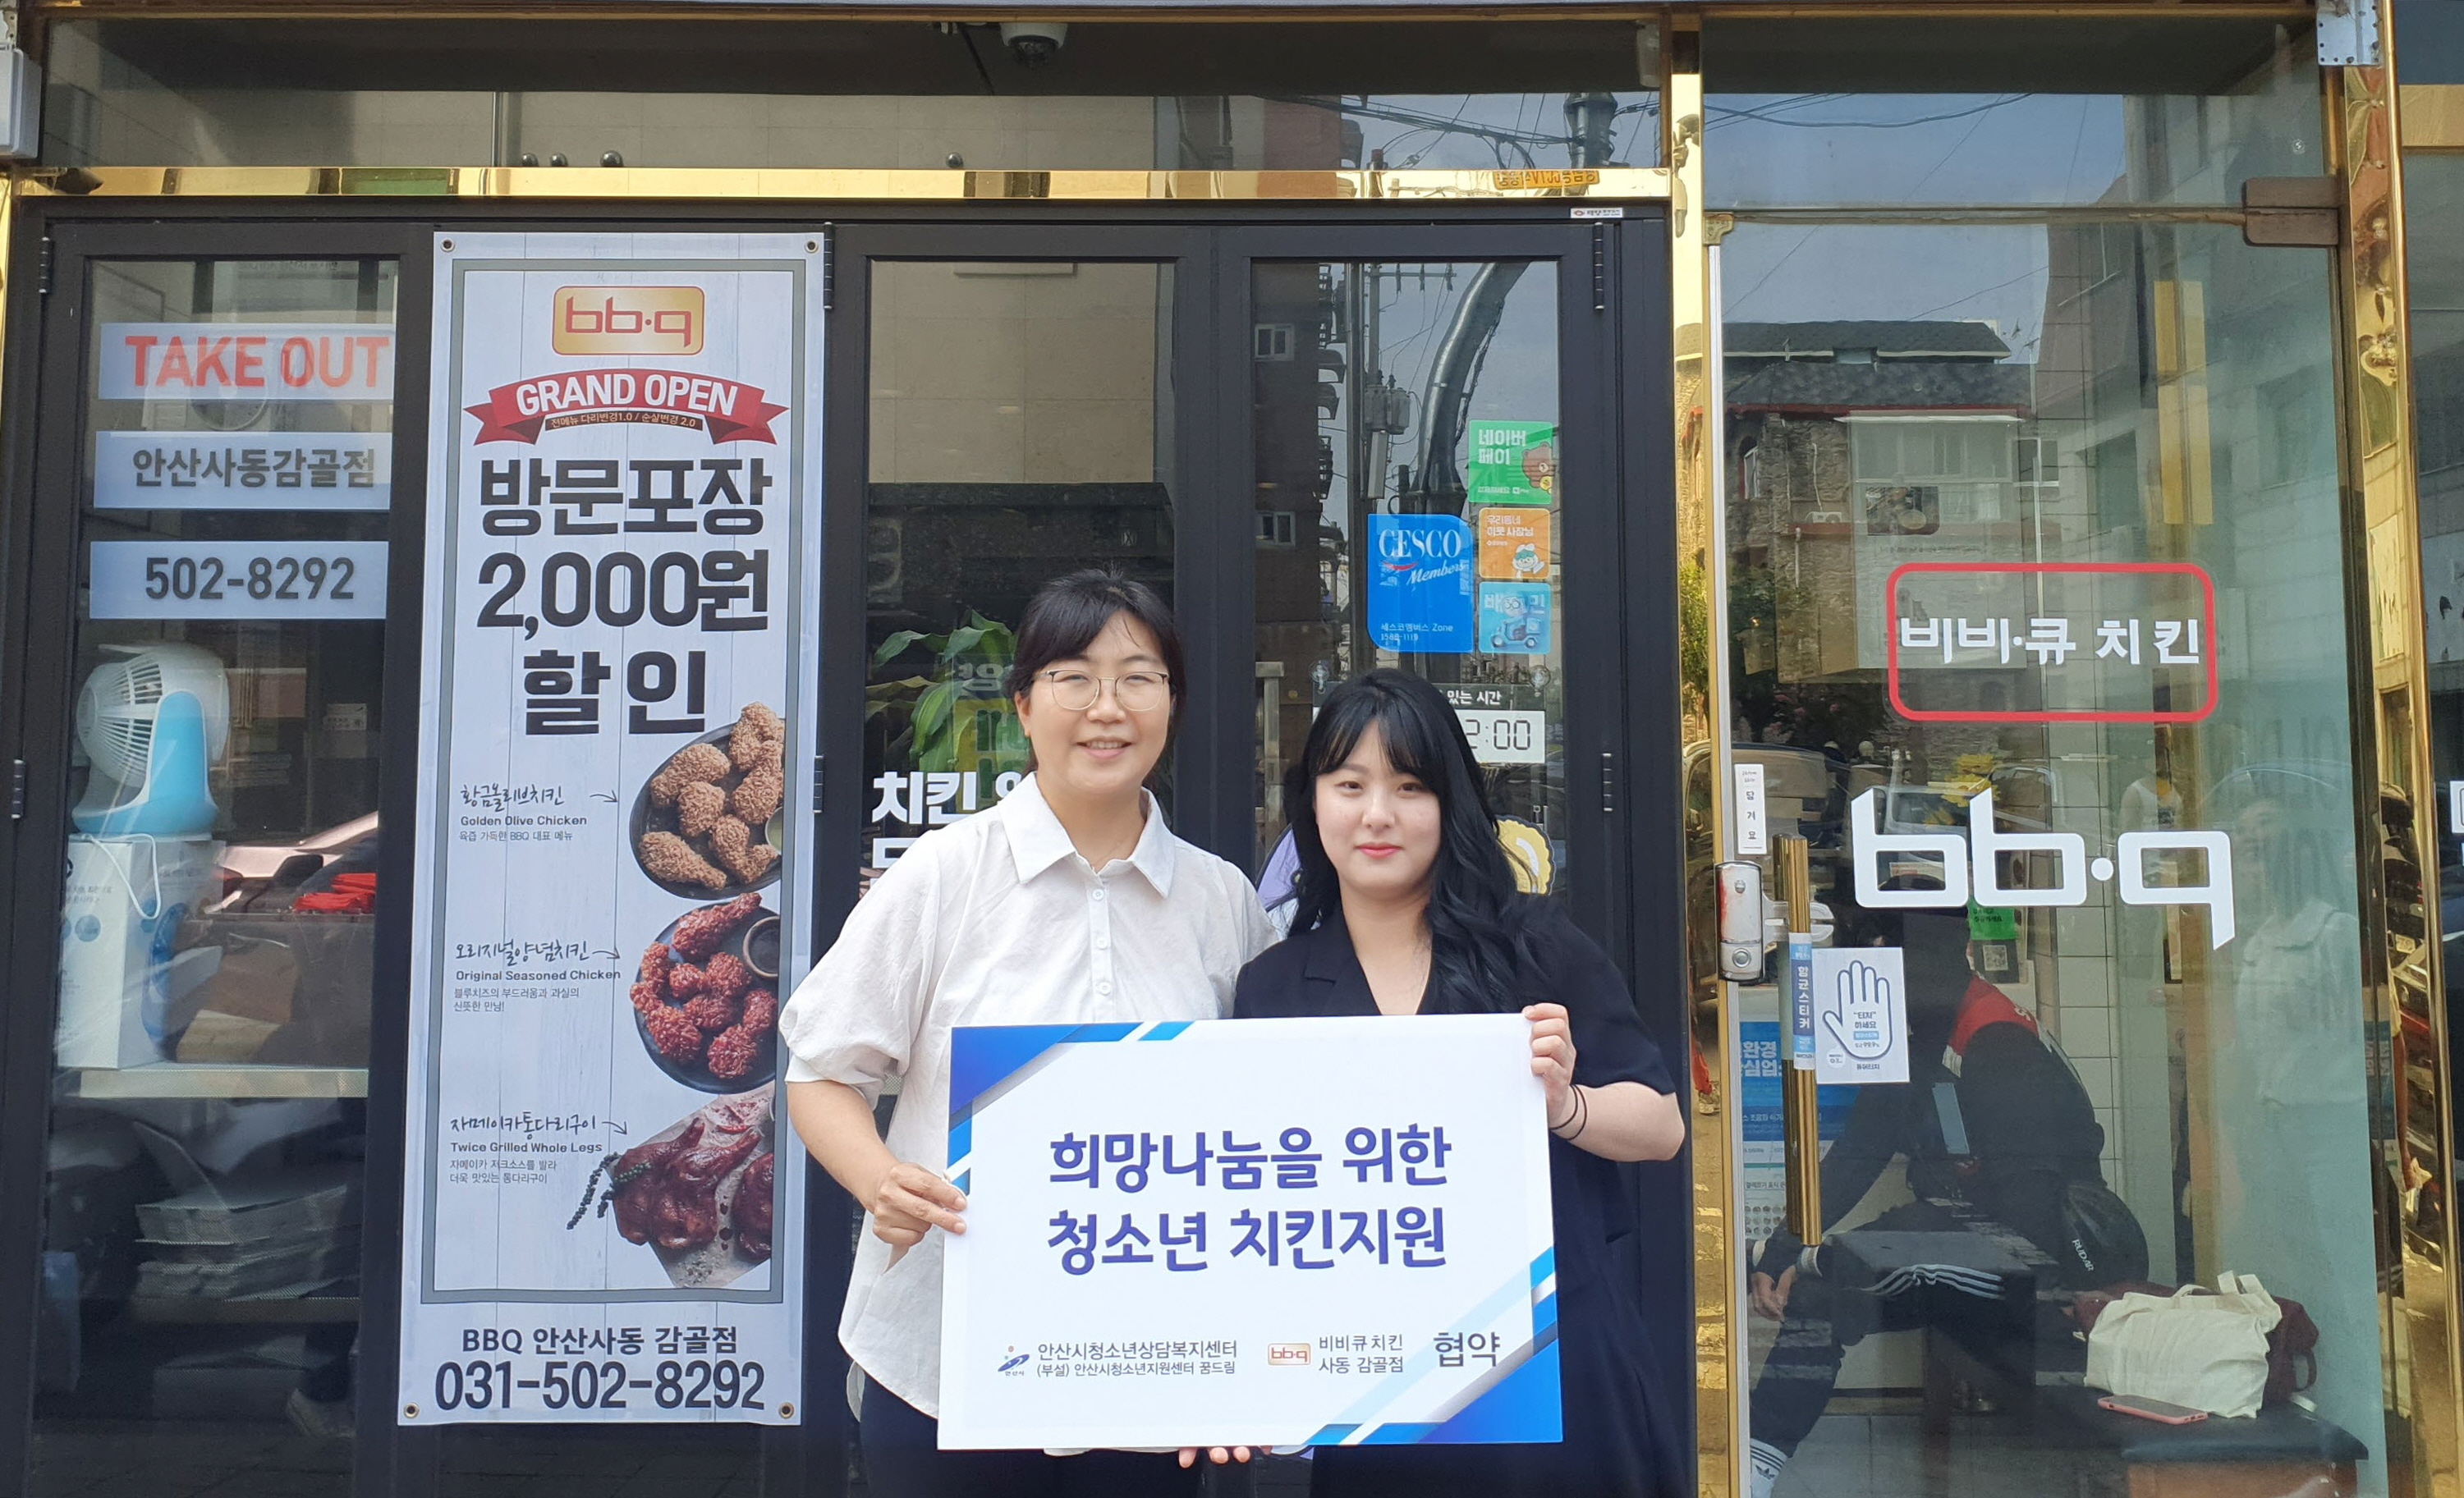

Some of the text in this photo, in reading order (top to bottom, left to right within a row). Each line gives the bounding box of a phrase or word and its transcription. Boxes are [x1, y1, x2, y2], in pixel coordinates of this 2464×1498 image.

[125, 337, 389, 387] TAKE OUT
[516, 374, 737, 417] GRAND OPEN
[551, 415, 578, 428] 전메뉴
[680, 417, 695, 427] 2.0
[1478, 429, 1526, 447] 네이버
[132, 448, 374, 488] 안산사동감골점
[1479, 448, 1510, 465] 페이
[480, 459, 772, 536] 방문포장
[1486, 515, 1521, 525] 우리동네
[1379, 529, 1461, 558] CESCO
[1507, 527, 1534, 538] 사장님
[145, 557, 354, 600] 502-8292
[477, 550, 769, 640] 2,000원
[1380, 623, 1453, 632] 세스코멤버스 Zone
[2095, 619, 2200, 664] 치킨
[523, 649, 706, 735] 할인
[1447, 690, 1502, 705] 있는 시간
[461, 782, 564, 812] 황금올리브치킨
[872, 771, 977, 824] 치킨
[461, 815, 587, 826] Golden Olive Chicken
[480, 831, 507, 841] 가득한
[510, 831, 529, 841] BBQ
[533, 831, 551, 841] 대표
[554, 830, 573, 841] 메뉴
[456, 938, 589, 966] 오리지널양념치킨
[457, 970, 621, 982] Original Seasoned Chicken
[502, 987, 548, 998] 부드러움과
[1740, 1041, 1777, 1059] 환경
[450, 1111, 595, 1140] 자메이카통다리구이
[451, 1142, 603, 1154] Twice Grilled Whole Legs
[1049, 1123, 1452, 1193] 희망나눔을 위한
[450, 1172, 548, 1184] 더욱 맛있는 통다리구이
[1048, 1207, 1448, 1275] 청소년 치킨지원
[462, 1326, 737, 1355] BBQ 안산사동 감골점
[1038, 1340, 1237, 1361] 안산시청소년상담복지센터
[1319, 1334, 1403, 1352] 비비큐 치킨
[1433, 1331, 1501, 1367] 협약
[1036, 1360, 1236, 1378] (부설) 안산시청소년지원센터 꿈드림
[1319, 1356, 1403, 1374] 사동 감골점
[435, 1360, 764, 1411] 031-502-8292
